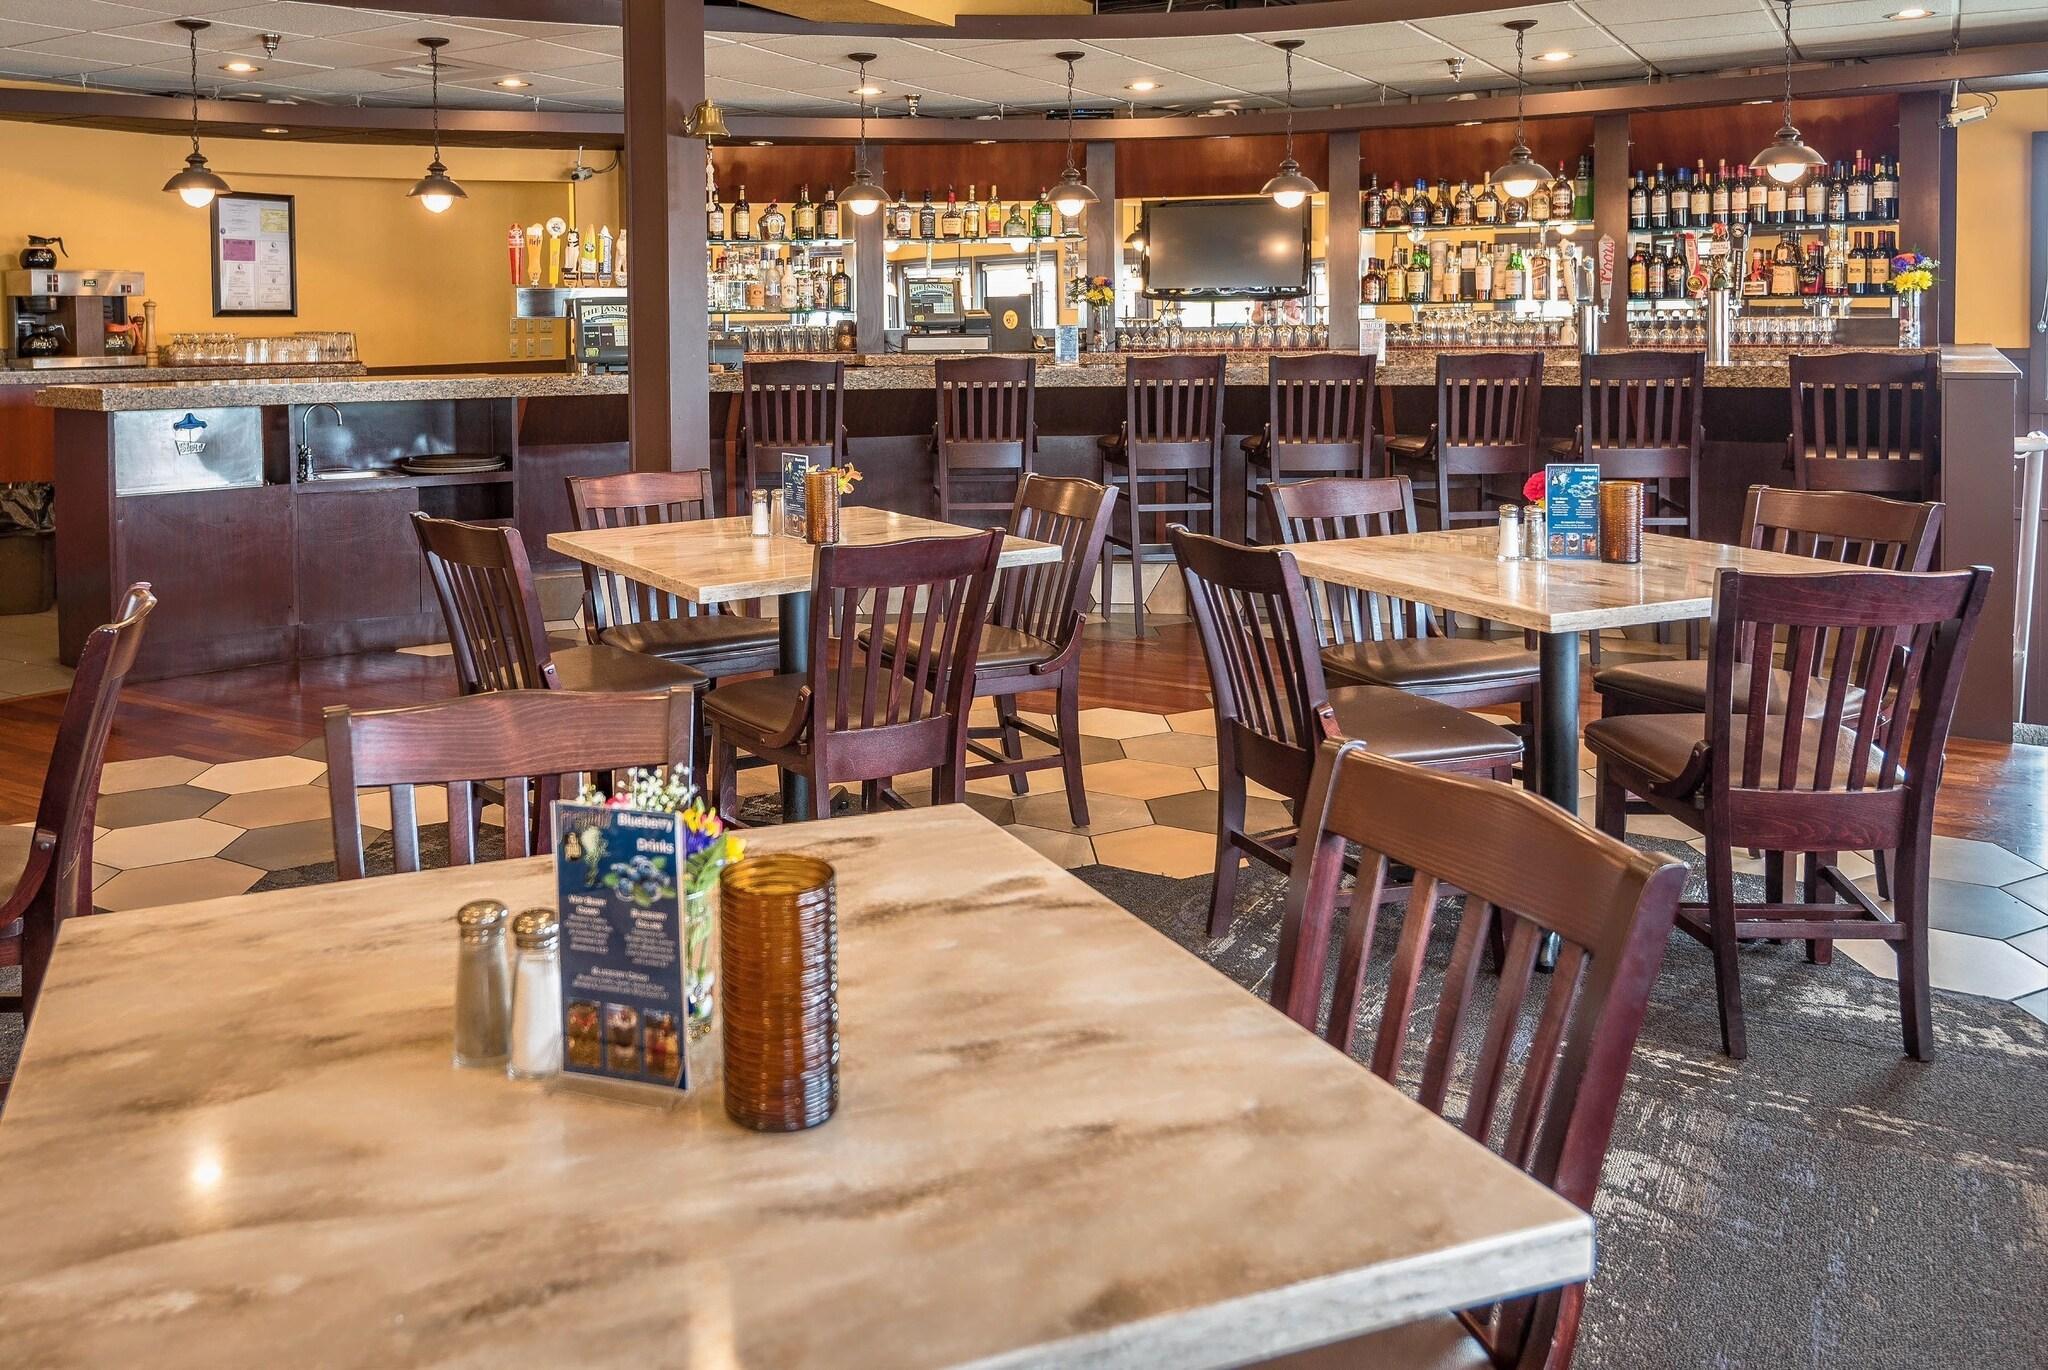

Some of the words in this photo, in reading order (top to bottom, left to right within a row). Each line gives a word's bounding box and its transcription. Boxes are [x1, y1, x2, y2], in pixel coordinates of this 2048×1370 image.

[583, 307, 599, 318] THE
[600, 304, 627, 316] LAND
[617, 812, 674, 833] Blueberry
[636, 837, 675, 855] Drinks
